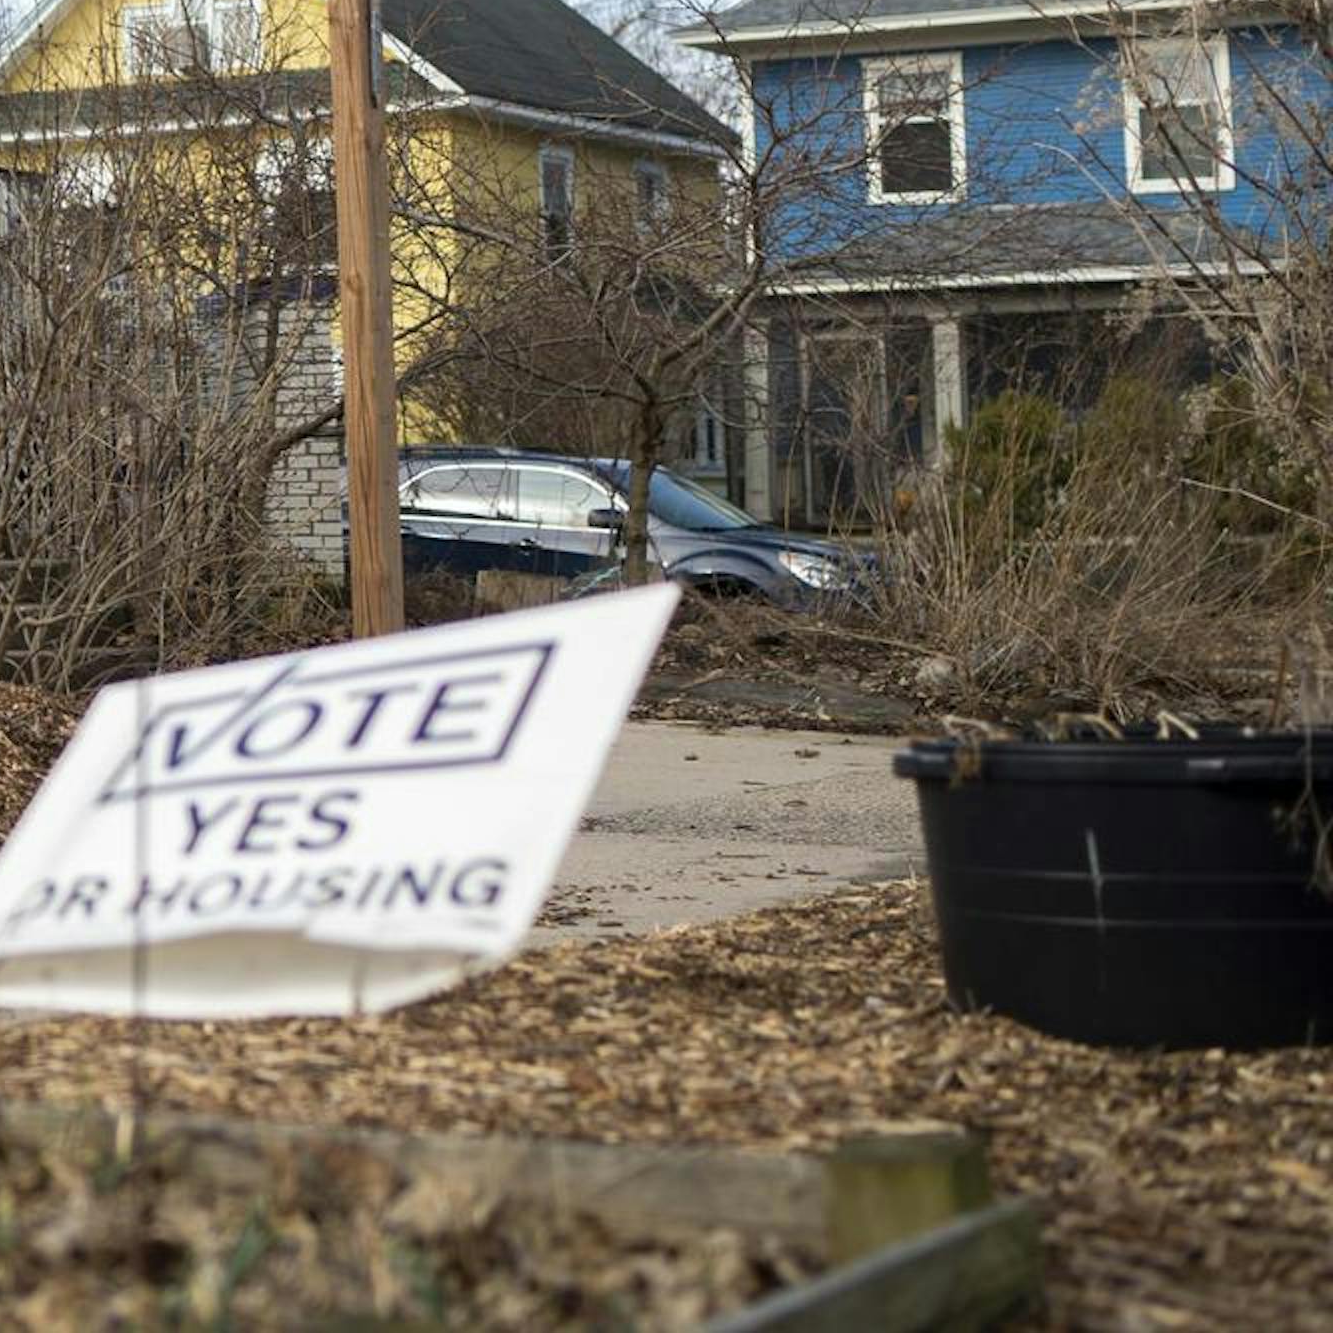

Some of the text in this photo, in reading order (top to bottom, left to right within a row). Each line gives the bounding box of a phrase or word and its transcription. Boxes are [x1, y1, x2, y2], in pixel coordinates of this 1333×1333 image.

[166, 661, 505, 770] VOTE
[182, 788, 360, 855] YES
[7, 854, 511, 921] OR HOUSING
